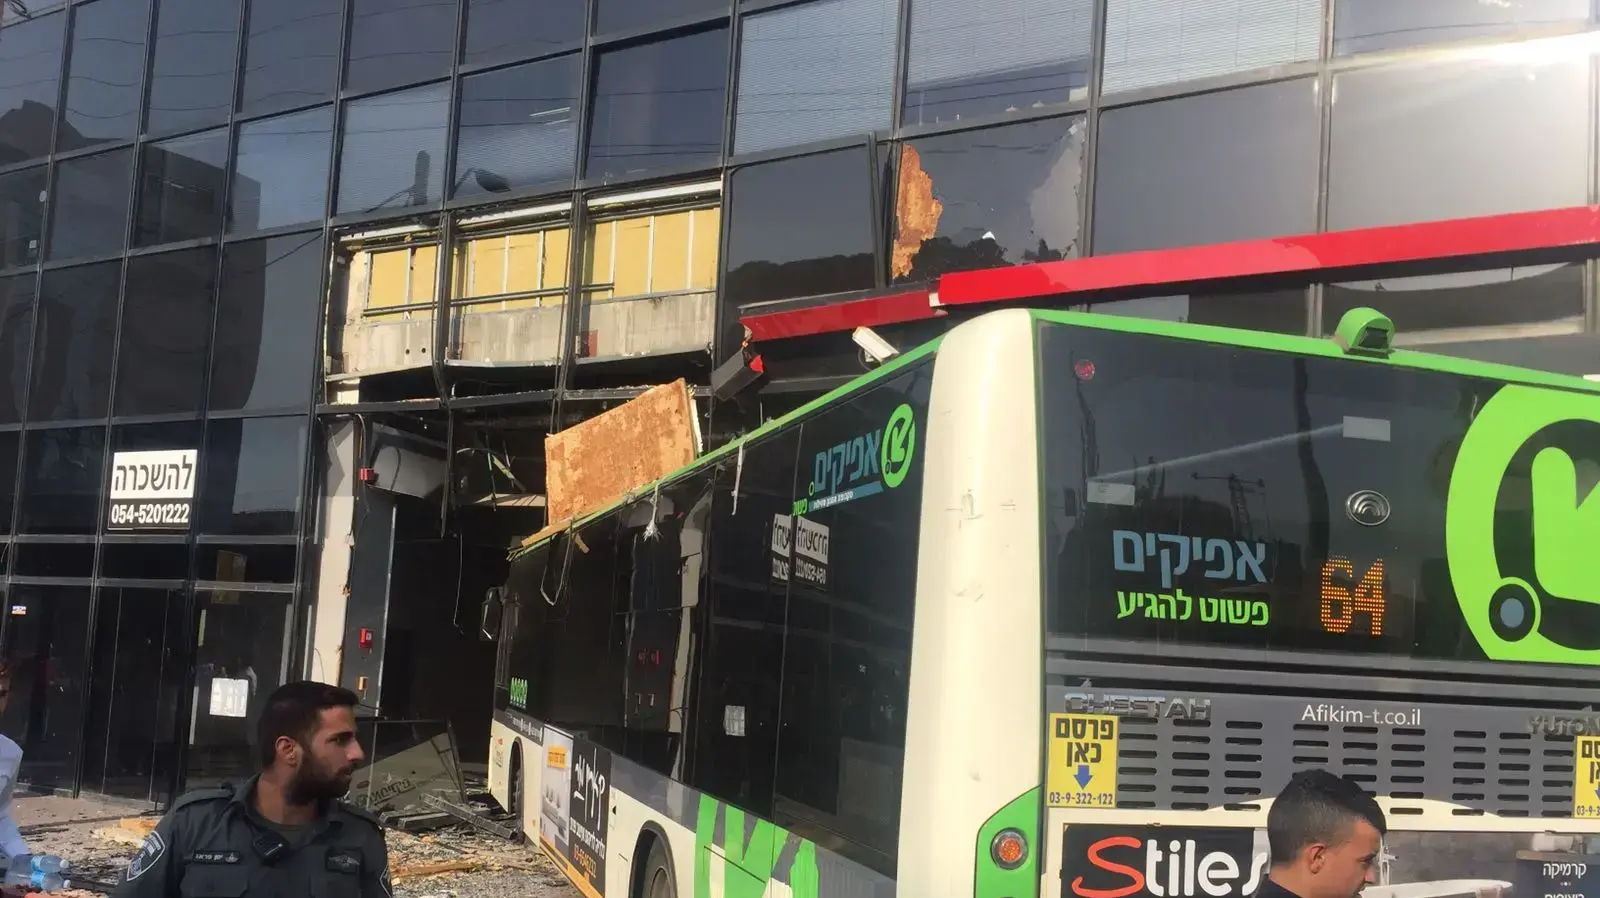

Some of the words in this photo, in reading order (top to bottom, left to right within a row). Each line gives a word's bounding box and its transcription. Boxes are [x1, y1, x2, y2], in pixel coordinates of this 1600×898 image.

[115, 455, 192, 491] להשכרה
[815, 428, 881, 495] אפיקים
[111, 503, 190, 524] 054-5201222
[1113, 529, 1266, 588] אפיקים
[1117, 589, 1192, 620] להגיע
[1320, 556, 1385, 638] 64
[1199, 597, 1269, 626] פשוט
[1065, 692, 1212, 720] CHEETAH
[1302, 704, 1420, 726] Afikim-t.co.il
[1056, 718, 1114, 740] פרסם
[1528, 714, 1600, 737] YUTON
[1066, 742, 1101, 767] כאן
[1049, 792, 1113, 805] 03-9-322-122
[1543, 863, 1587, 879] קרמיקה
